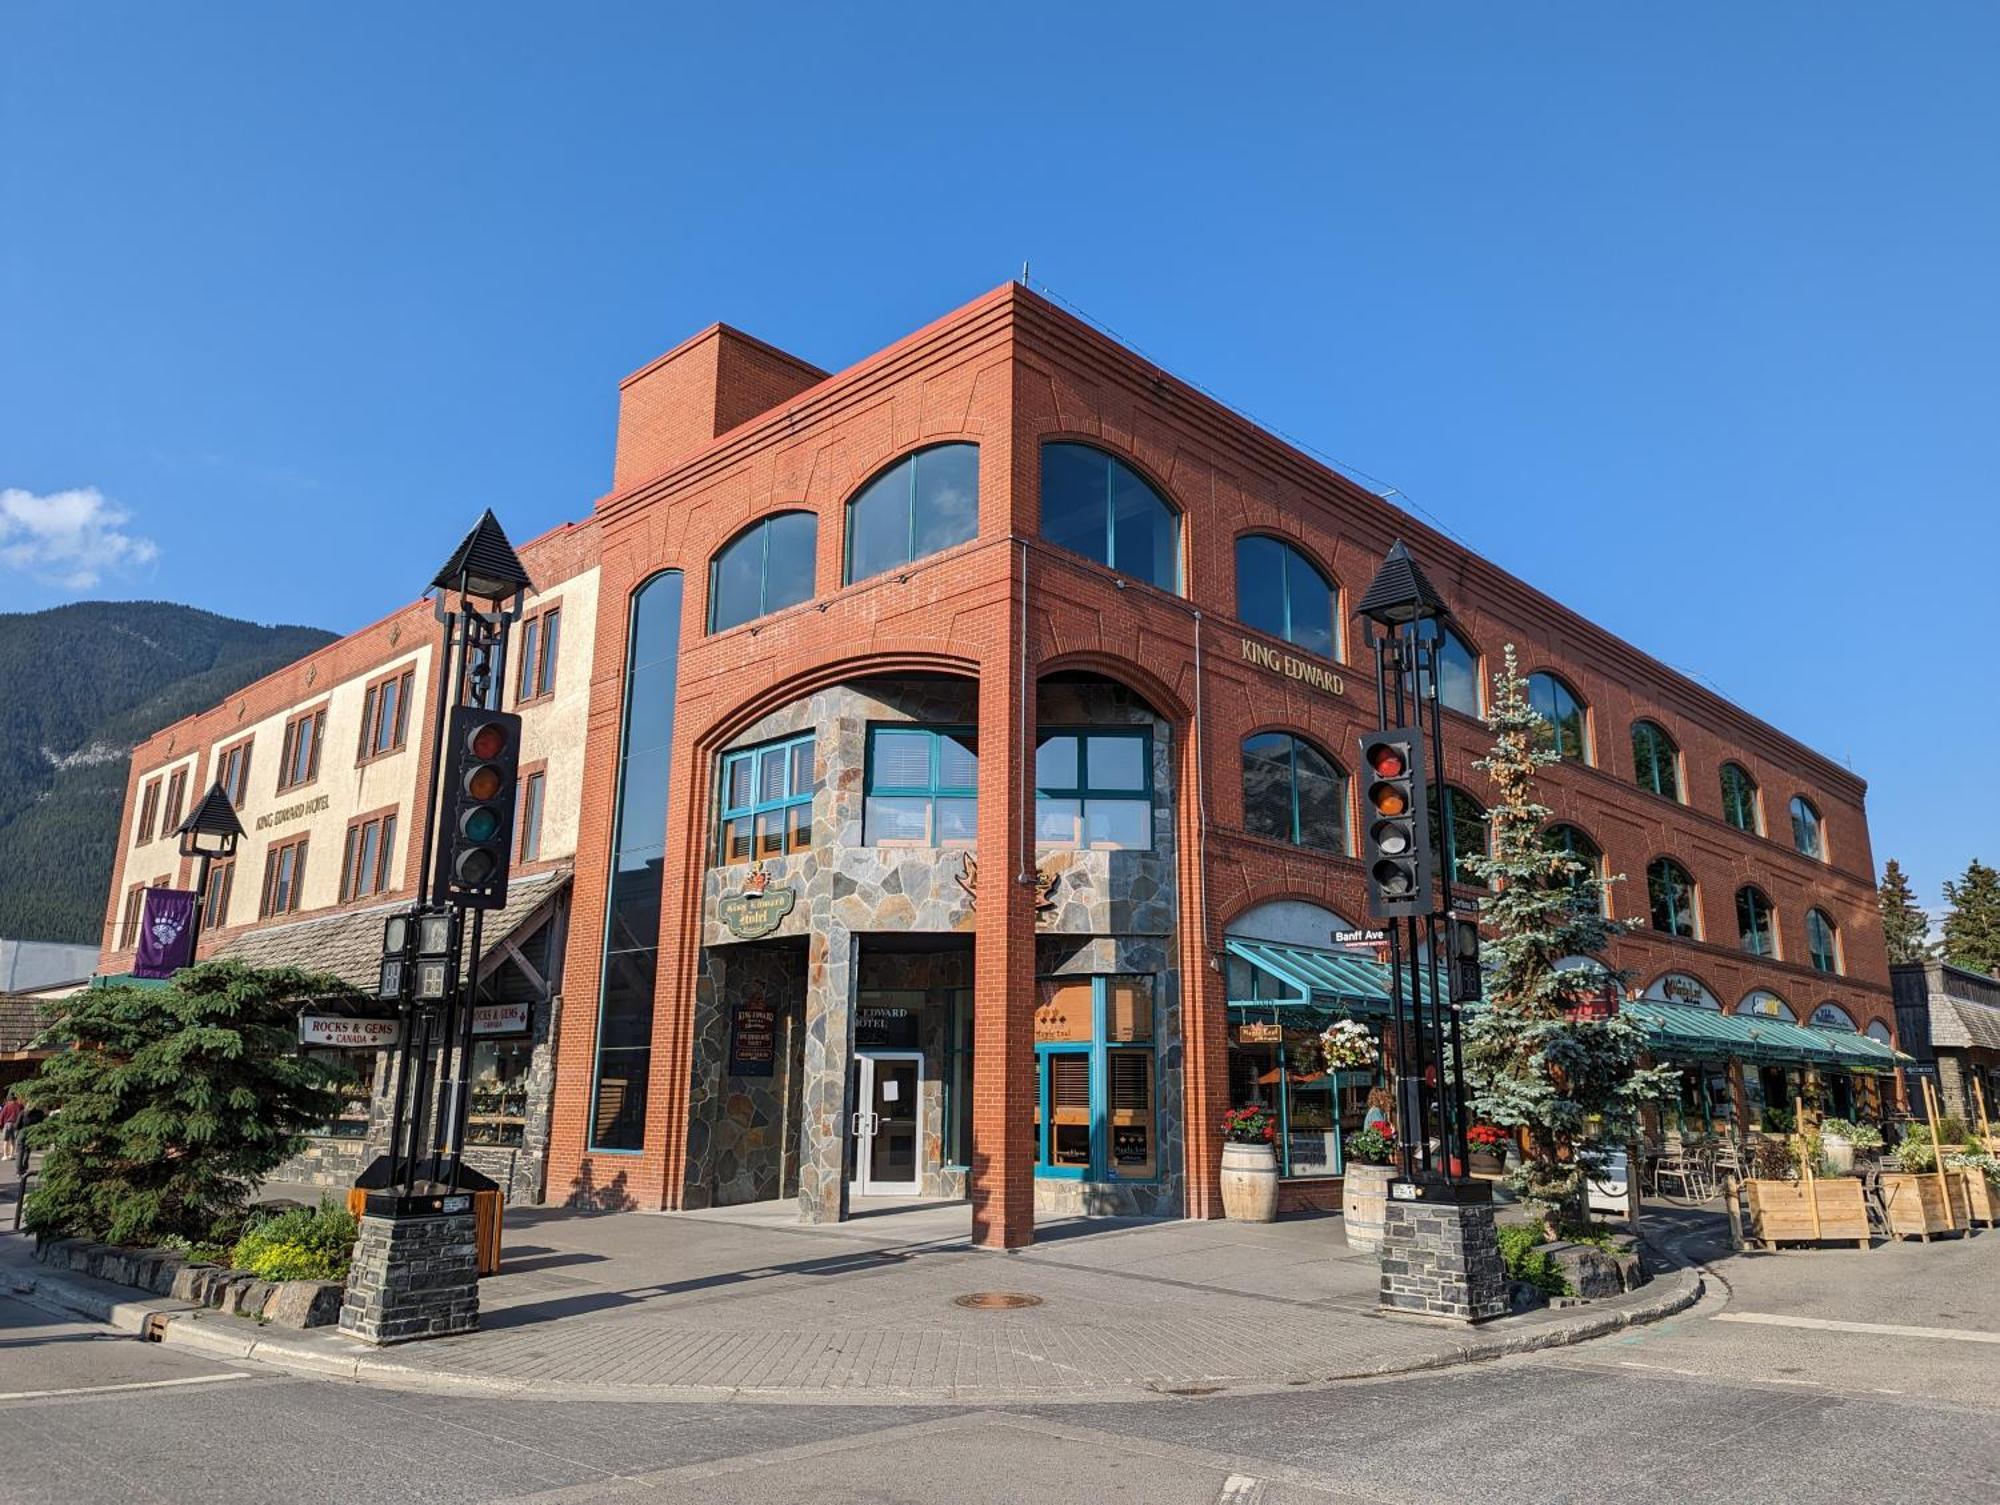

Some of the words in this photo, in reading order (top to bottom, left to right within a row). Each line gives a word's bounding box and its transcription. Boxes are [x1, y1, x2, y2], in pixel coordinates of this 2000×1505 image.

[1241, 639, 1280, 672] KING
[1284, 655, 1344, 695] EDWARD
[256, 813, 273, 831] KING
[274, 803, 304, 826] EDWARD
[1335, 930, 1362, 942] Banff
[1364, 930, 1384, 940] Ave
[474, 1010, 491, 1021] OCKS
[863, 1008, 908, 1017] EDWARD
[312, 1021, 348, 1033] ROCKS
[352, 1023, 361, 1034] &
[364, 1023, 393, 1035] GEMS
[336, 1033, 367, 1044] CANADA
